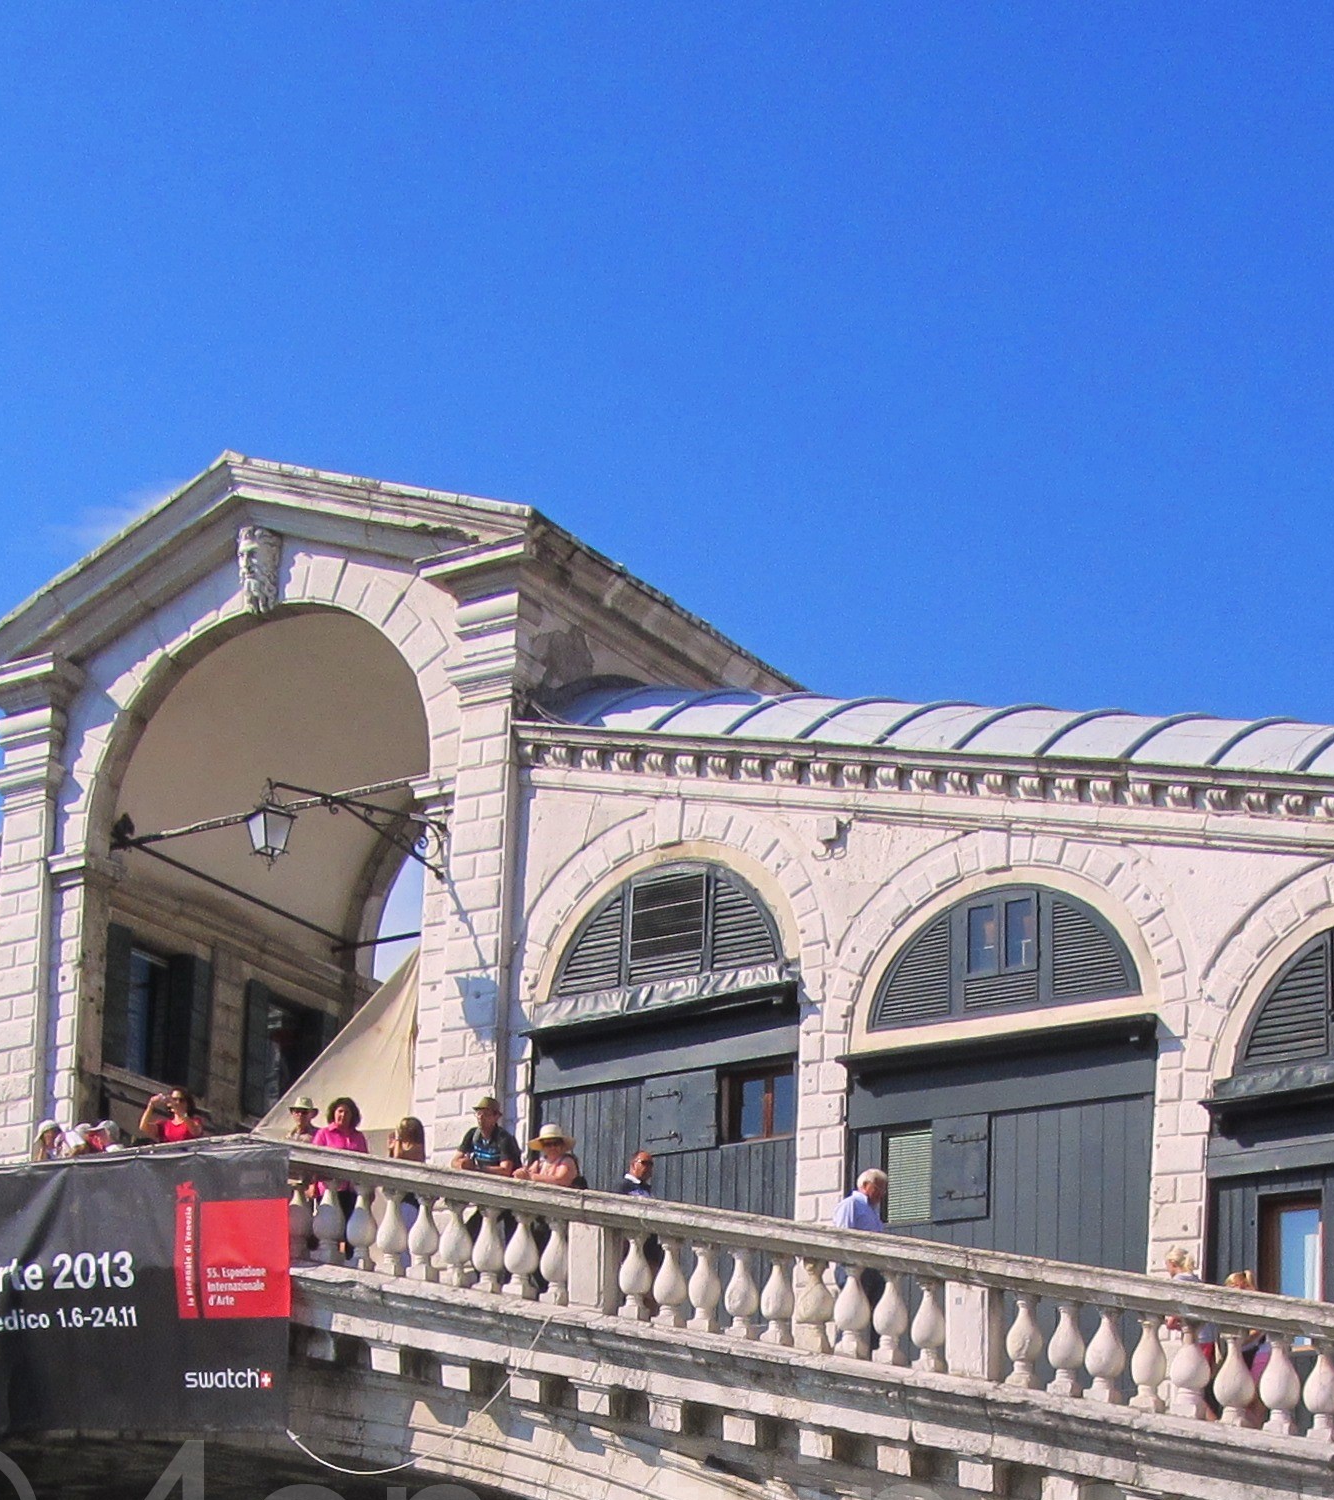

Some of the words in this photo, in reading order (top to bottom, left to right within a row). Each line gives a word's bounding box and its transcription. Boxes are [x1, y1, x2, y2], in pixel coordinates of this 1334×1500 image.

[53, 1250, 135, 1291] 2013
[221, 1265, 267, 1280] Esposizione
[207, 1279, 266, 1292] Internazionale
[208, 1294, 235, 1307] d'Arte
[56, 1306, 138, 1329] 1.6-24.11
[185, 1368, 259, 1389] swatch
